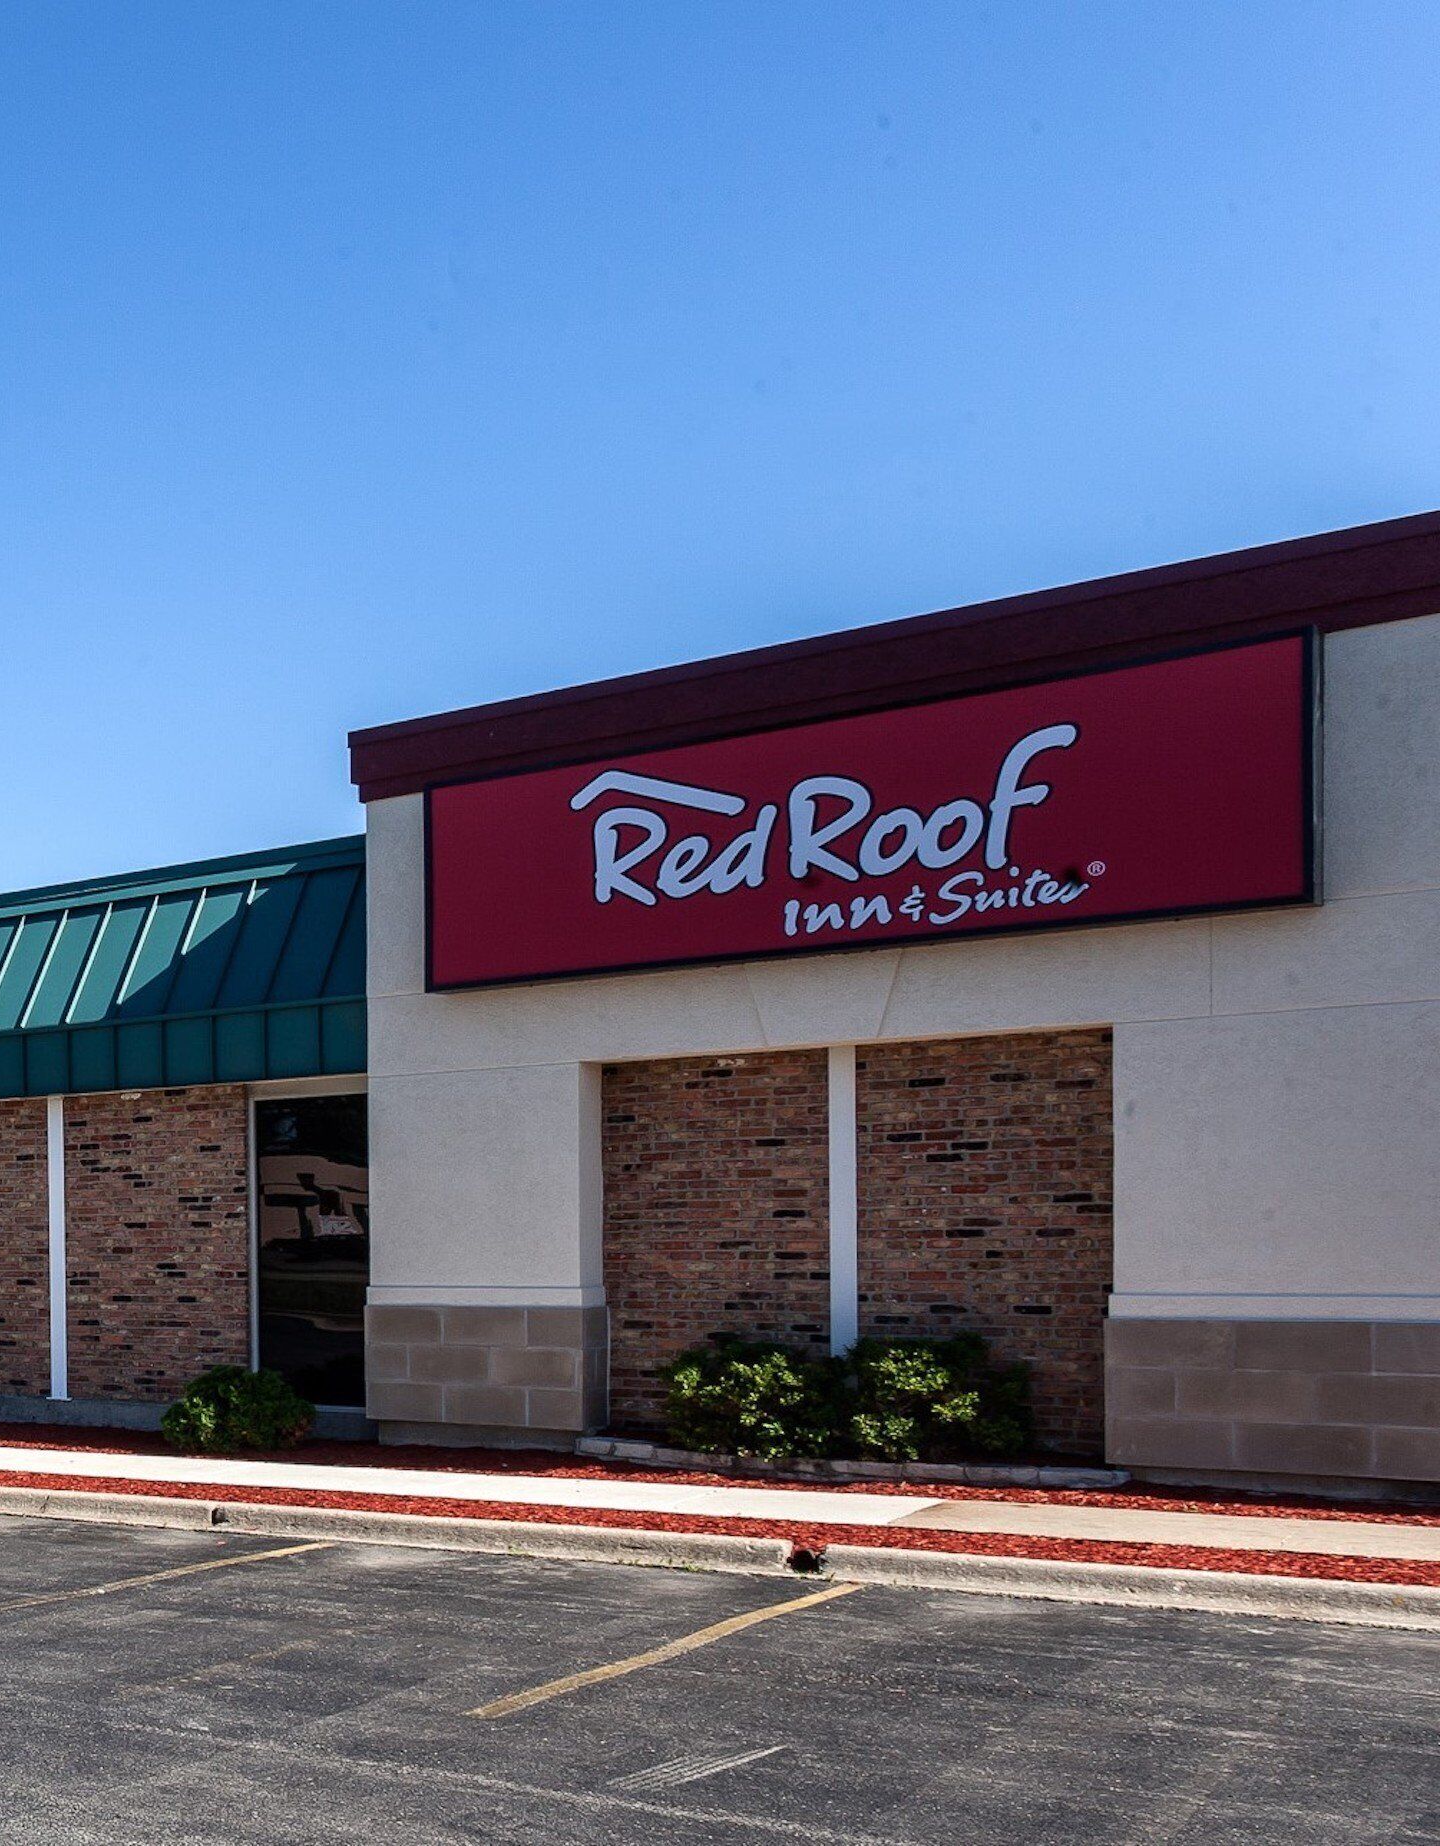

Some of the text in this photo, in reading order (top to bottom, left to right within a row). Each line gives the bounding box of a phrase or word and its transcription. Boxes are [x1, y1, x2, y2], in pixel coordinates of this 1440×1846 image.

[593, 723, 1077, 906] Red Roof
[784, 895, 891, 936] Inn
[899, 885, 925, 922] &
[929, 866, 1089, 925] Suites
